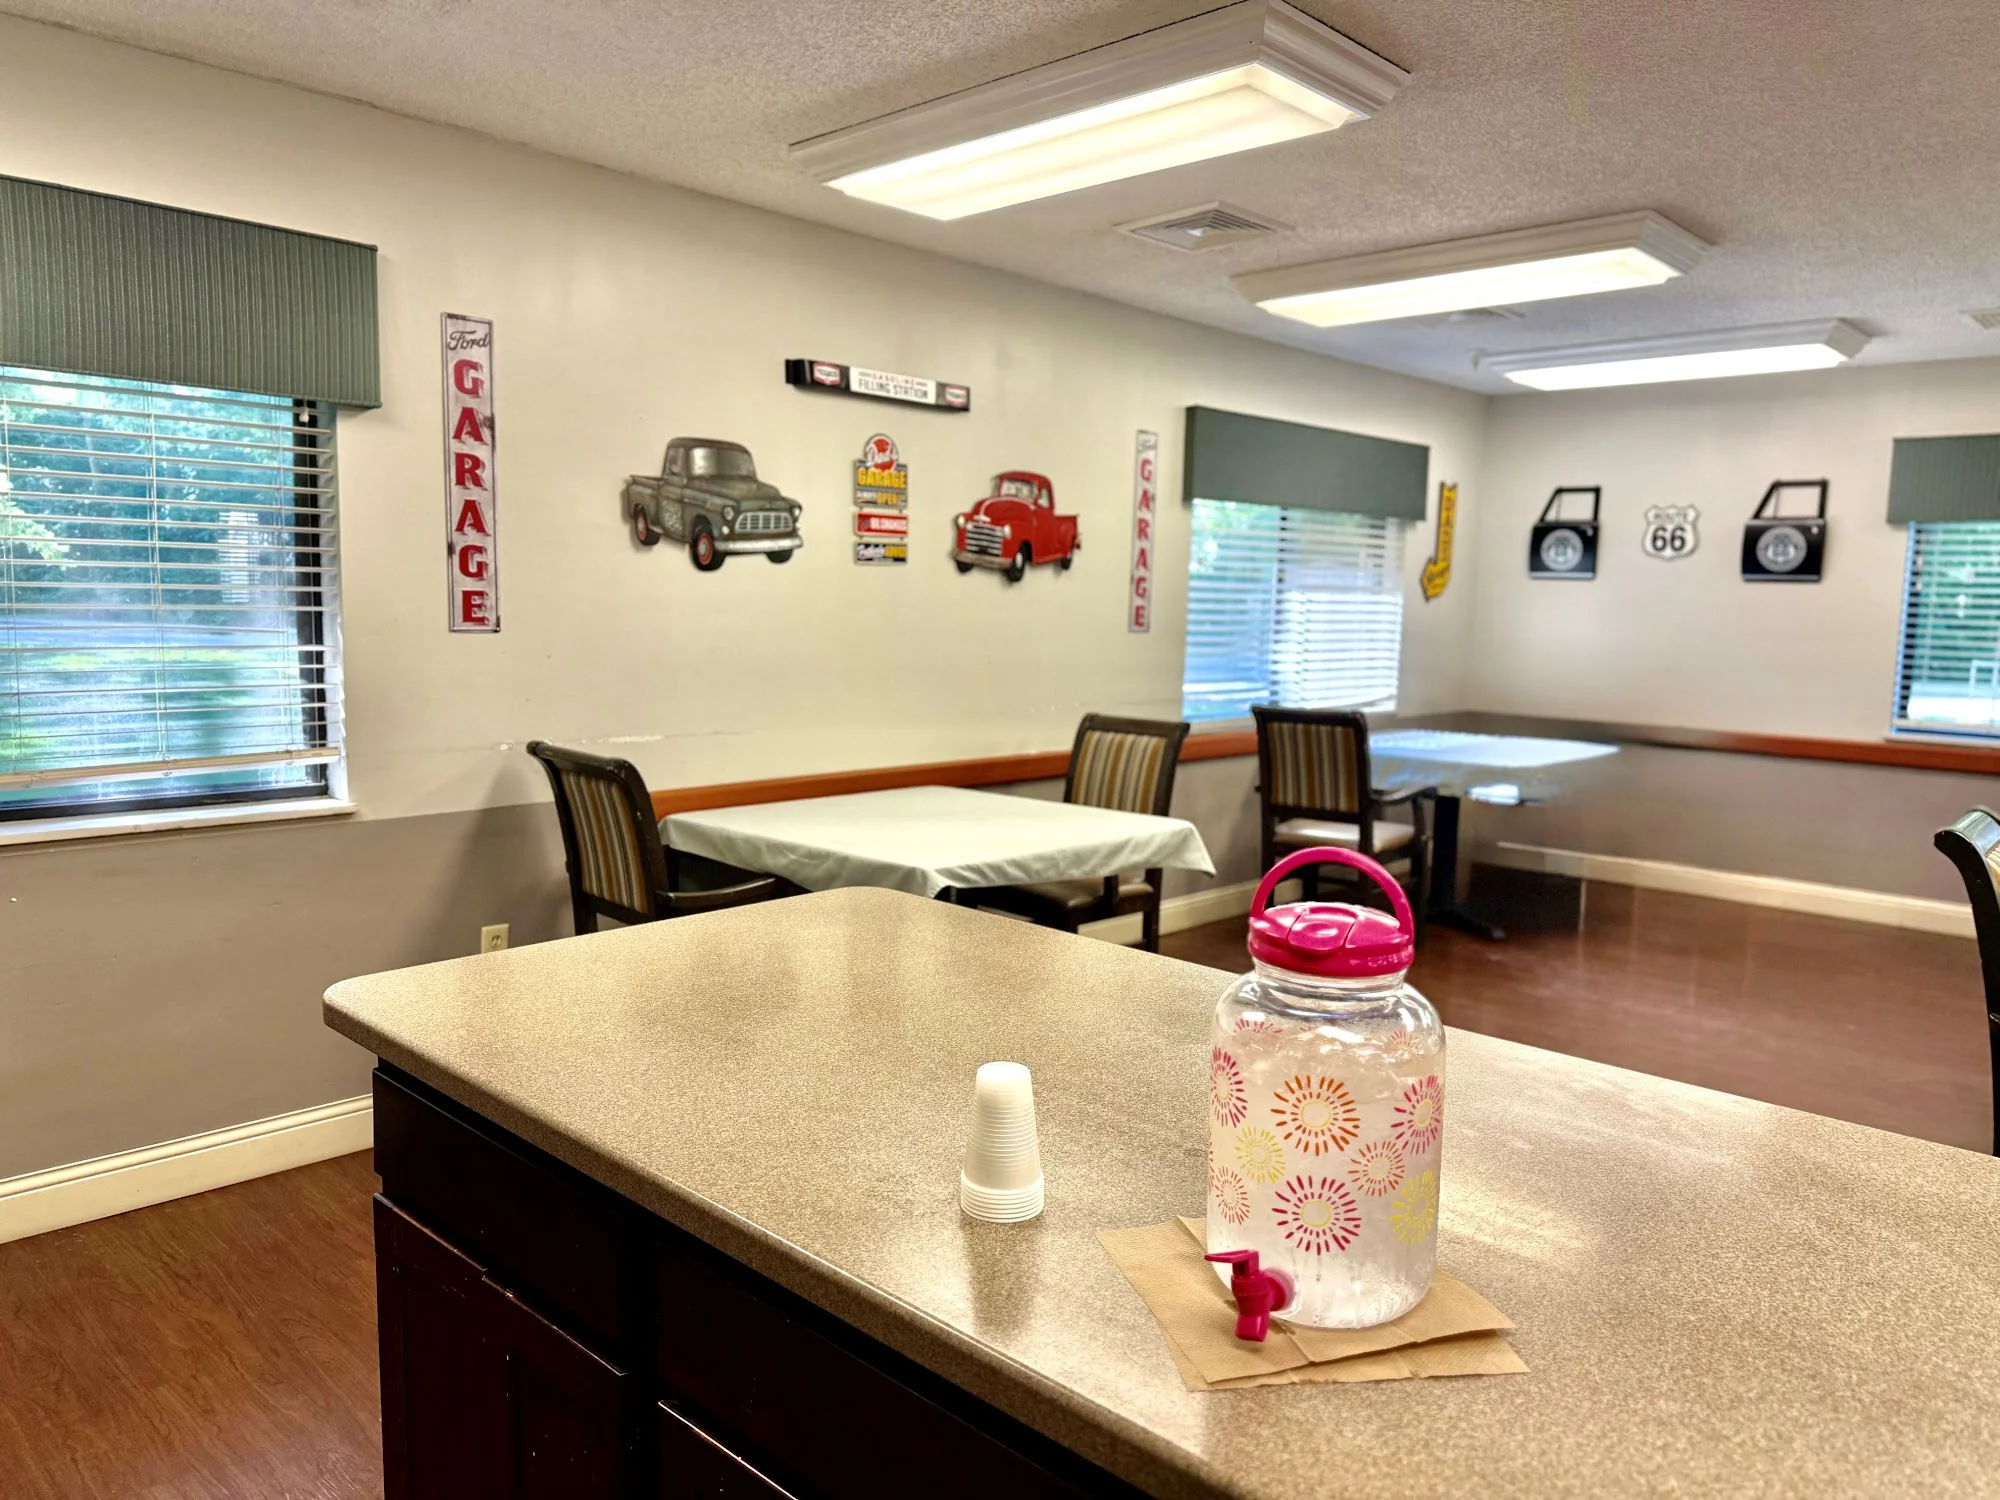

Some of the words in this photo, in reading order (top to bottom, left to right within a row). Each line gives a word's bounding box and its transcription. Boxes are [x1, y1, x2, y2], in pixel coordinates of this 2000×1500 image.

[447, 330, 489, 351] Ford
[858, 378, 891, 394] FILLING
[893, 384, 929, 399] STATION
[857, 466, 907, 489] GARAGE
[452, 358, 491, 627] GARAGE
[1133, 458, 1152, 628] GARAGE
[1652, 526, 1686, 551] 66
